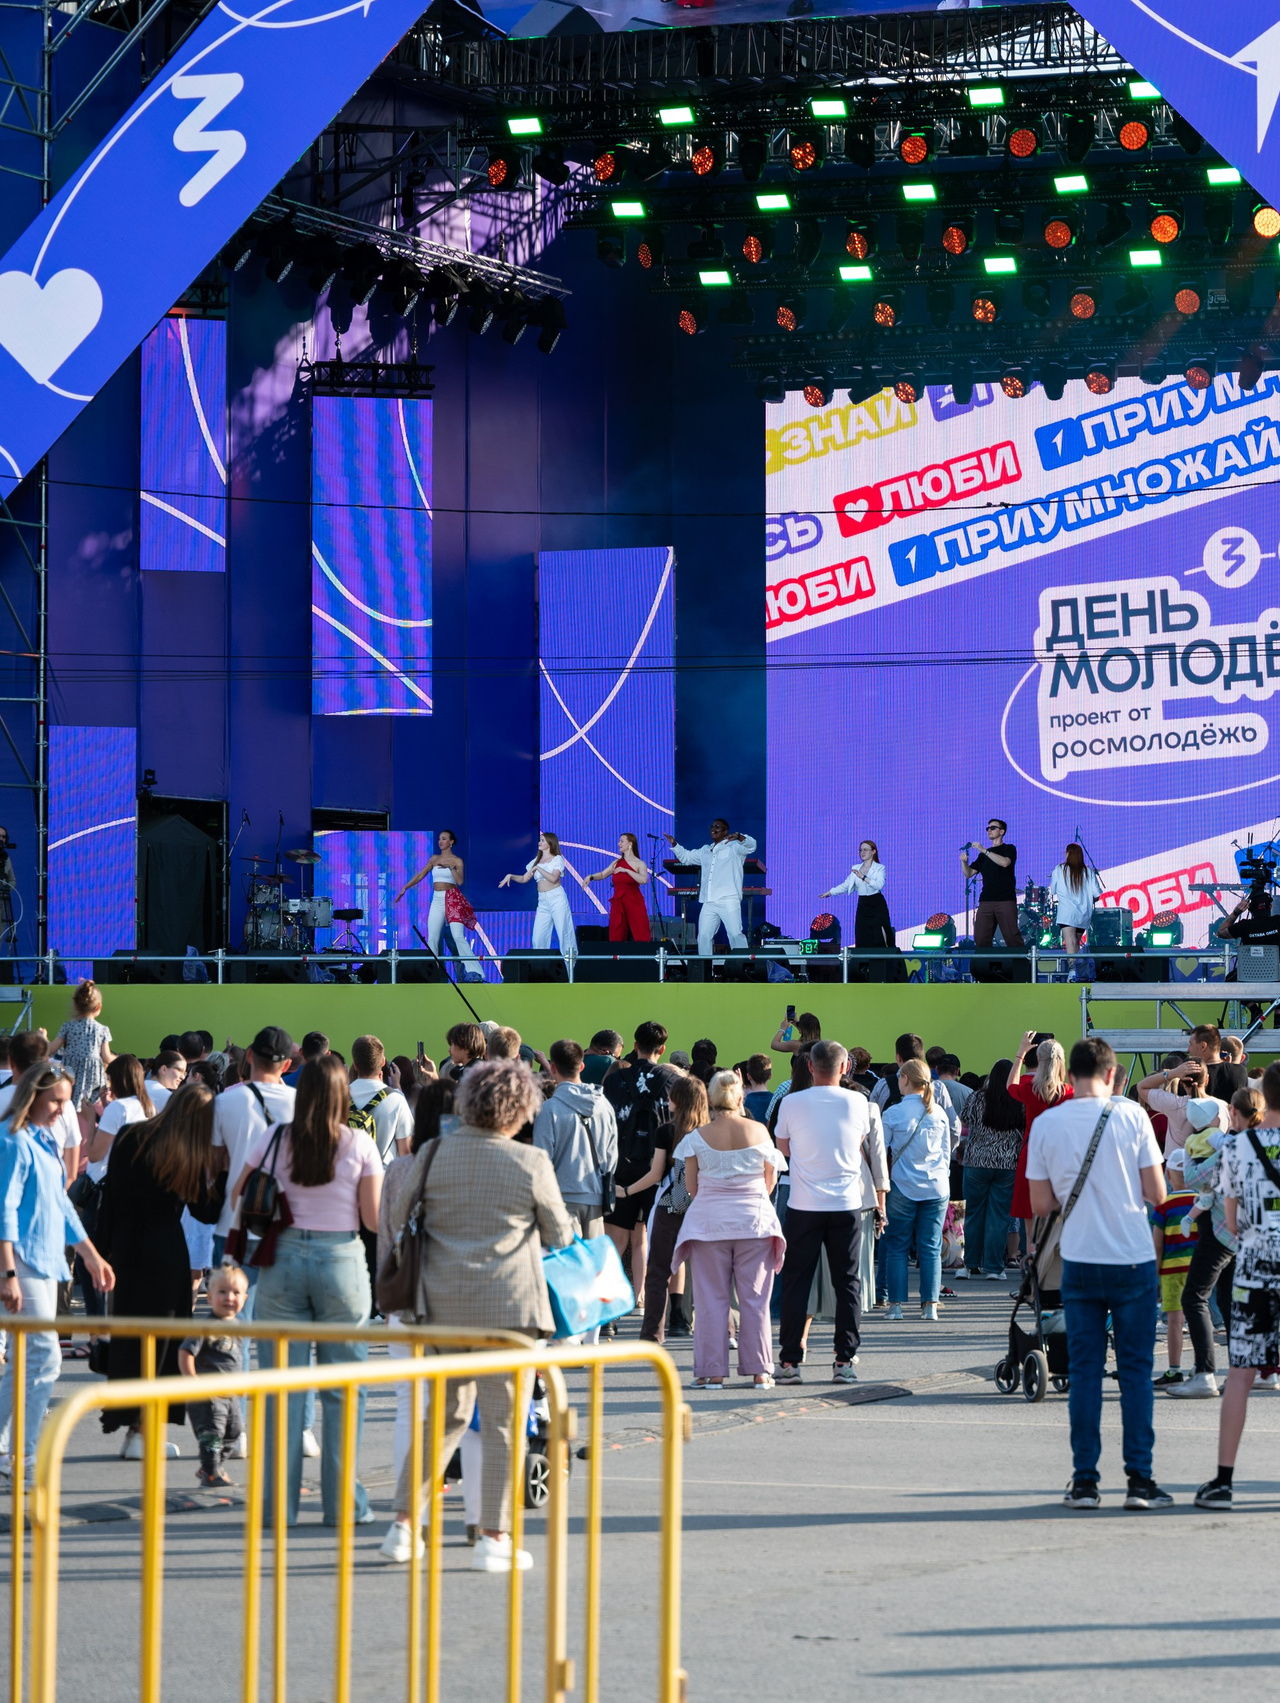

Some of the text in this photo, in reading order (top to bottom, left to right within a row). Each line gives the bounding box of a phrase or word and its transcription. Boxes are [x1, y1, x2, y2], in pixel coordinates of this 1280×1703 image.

[780, 388, 912, 459] ЗНАЙ
[879, 445, 1019, 517] ЛЮБИ
[766, 560, 872, 622] ЮБИ
[1045, 589, 1200, 652] ДЕНЬ
[1049, 706, 1152, 731] проект от
[1051, 724, 1258, 768] росмолодёжь
[1095, 866, 1214, 922] ЮБИ
